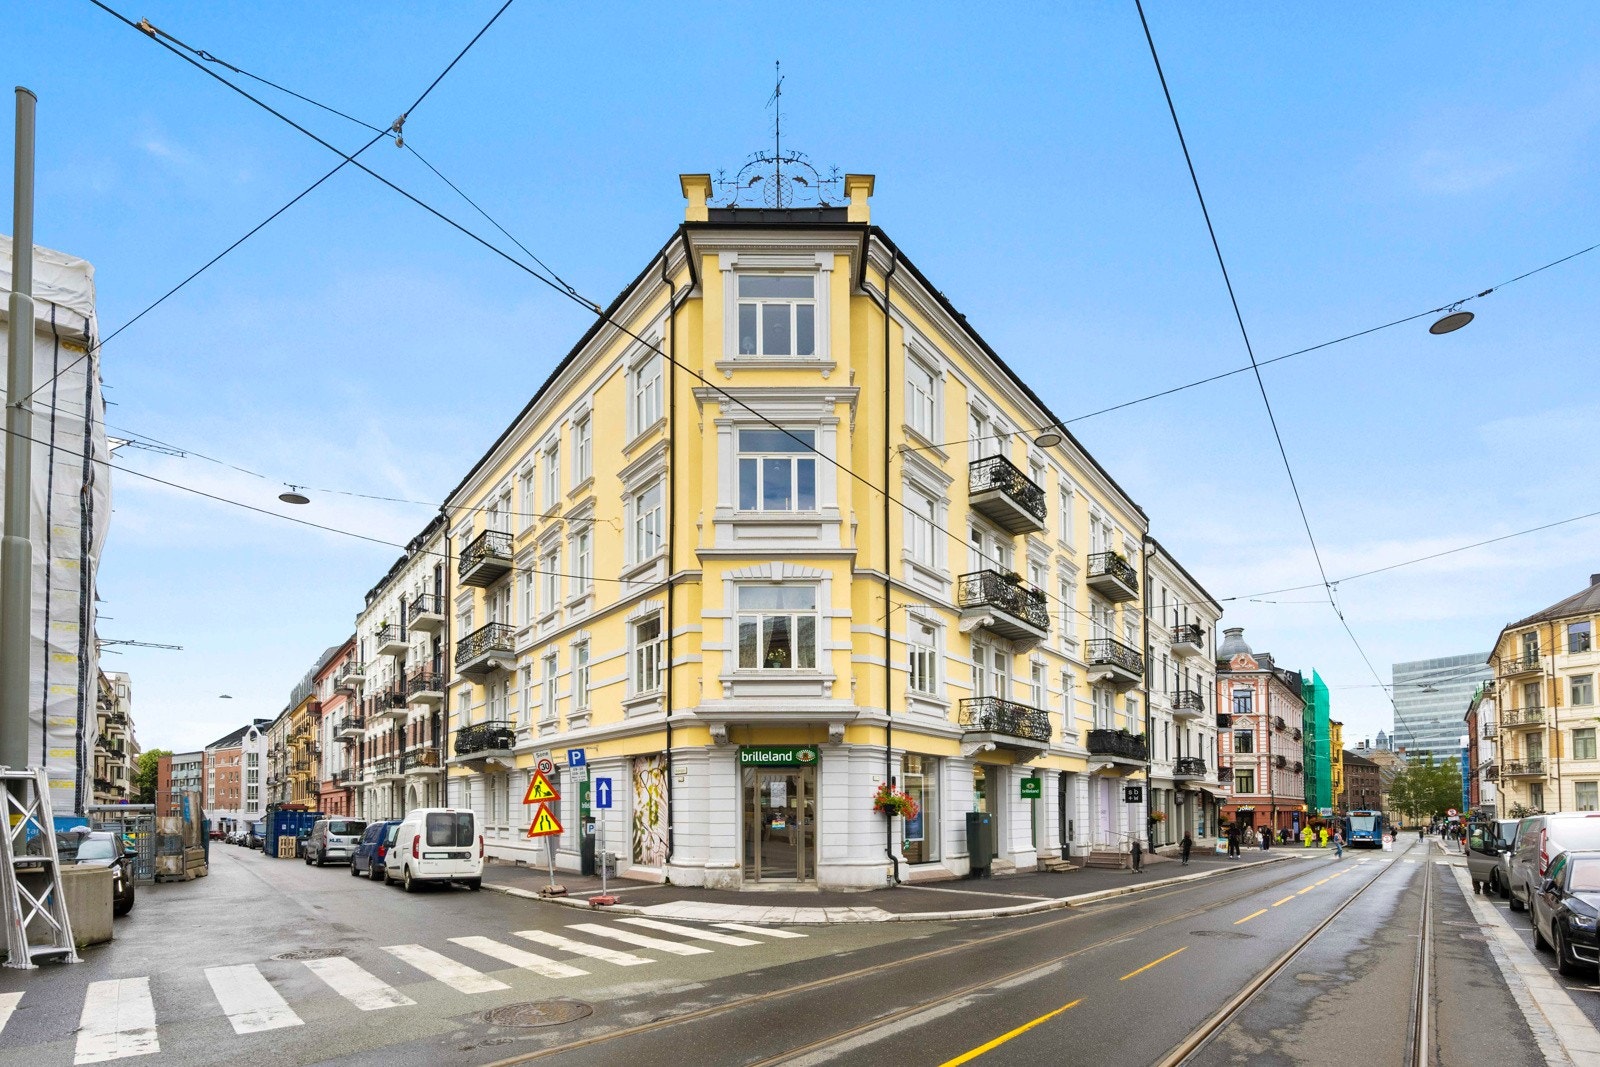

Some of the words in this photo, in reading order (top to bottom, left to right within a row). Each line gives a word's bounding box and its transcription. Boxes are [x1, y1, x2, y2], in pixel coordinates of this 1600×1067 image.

[571, 750, 582, 765] P
[741, 751, 793, 762] brilleland
[540, 763, 549, 771] 30
[1238, 804, 1255, 812] joker
[588, 824, 595, 833] P
